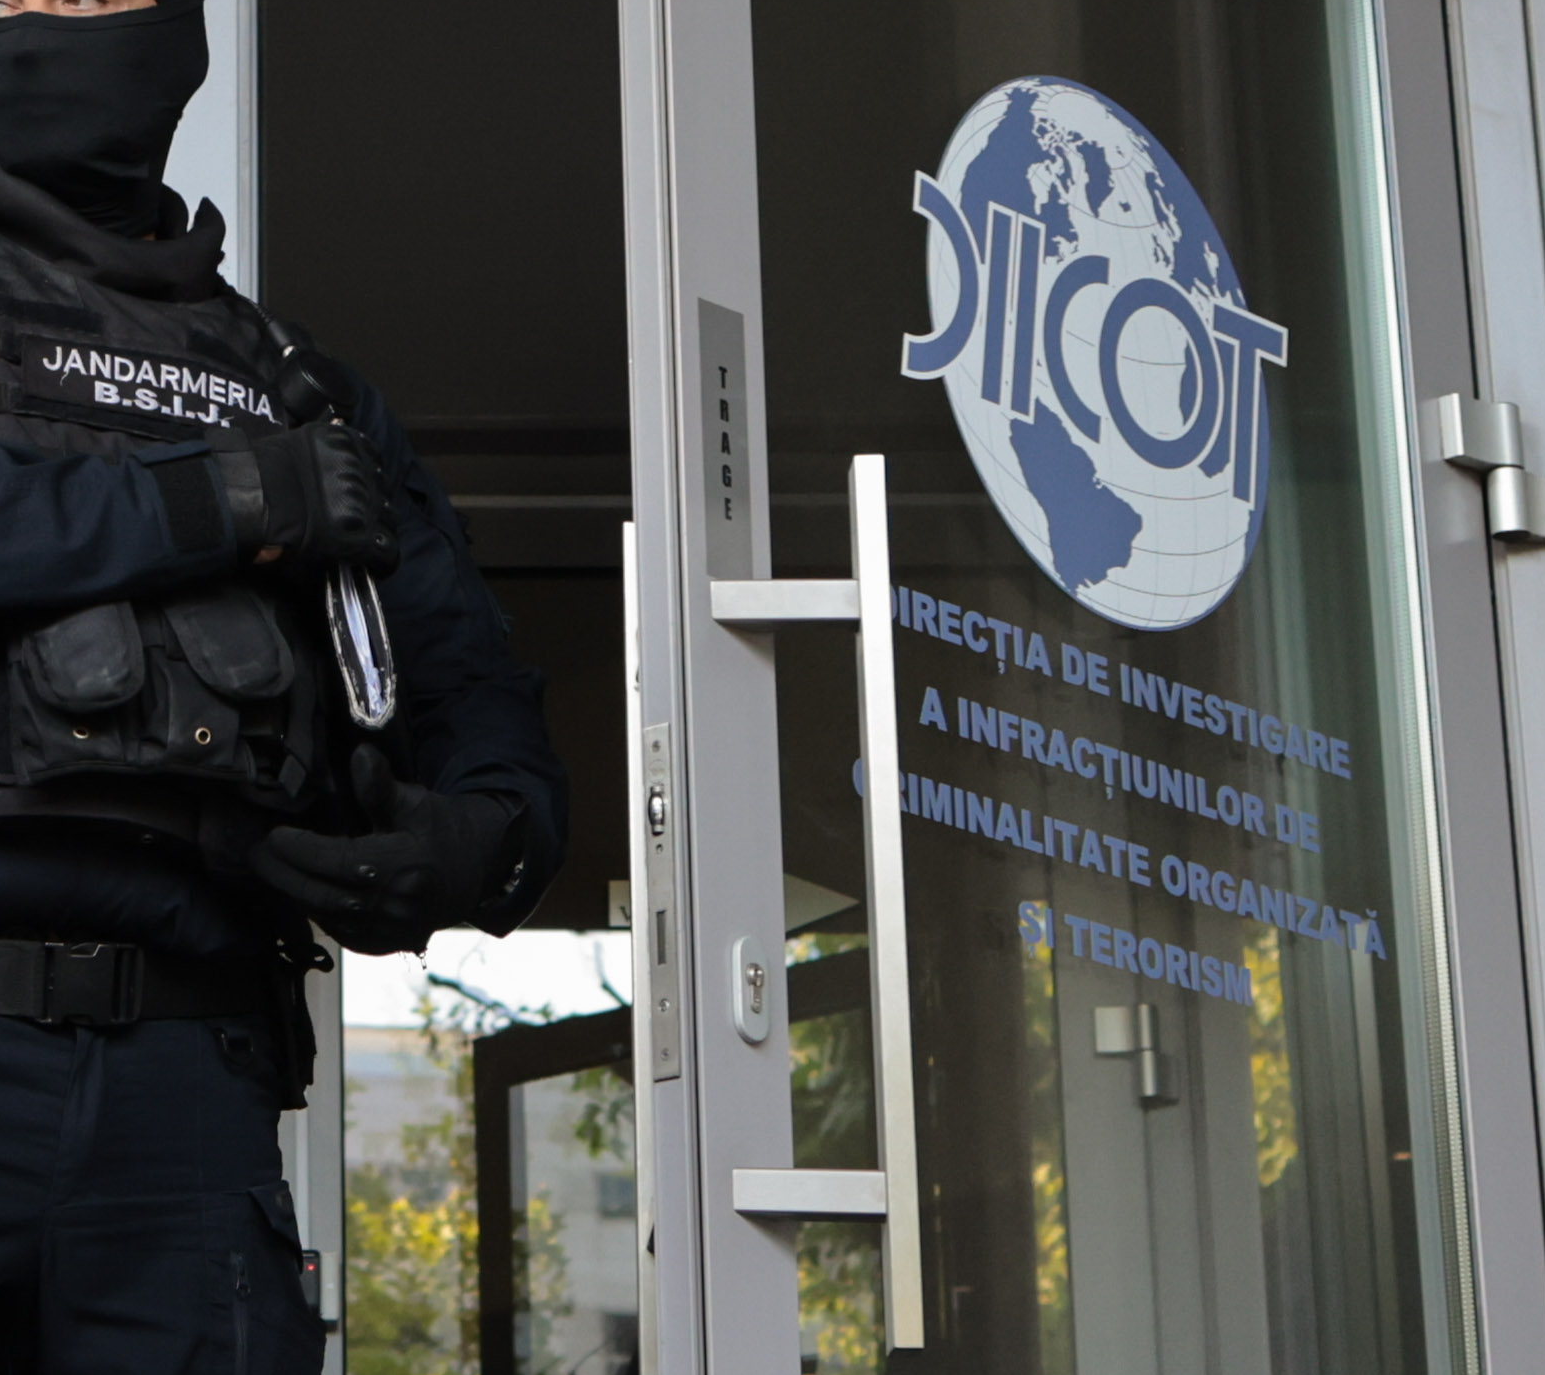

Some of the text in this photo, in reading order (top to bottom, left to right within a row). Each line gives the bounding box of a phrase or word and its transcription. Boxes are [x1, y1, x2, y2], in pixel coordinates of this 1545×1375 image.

[42, 346, 282, 425] JANDARMERIA
[94, 380, 231, 428] B.S.I.J.
[718, 366, 732, 521] TRAGE
[890, 585, 1352, 780] IRECȚIA DE INVESTIGARE
[919, 686, 948, 732] A
[1275, 803, 1322, 854] DE
[1064, 914, 1253, 1007] TERORISM
[1161, 854, 1388, 961] ORGANIZATĂ
